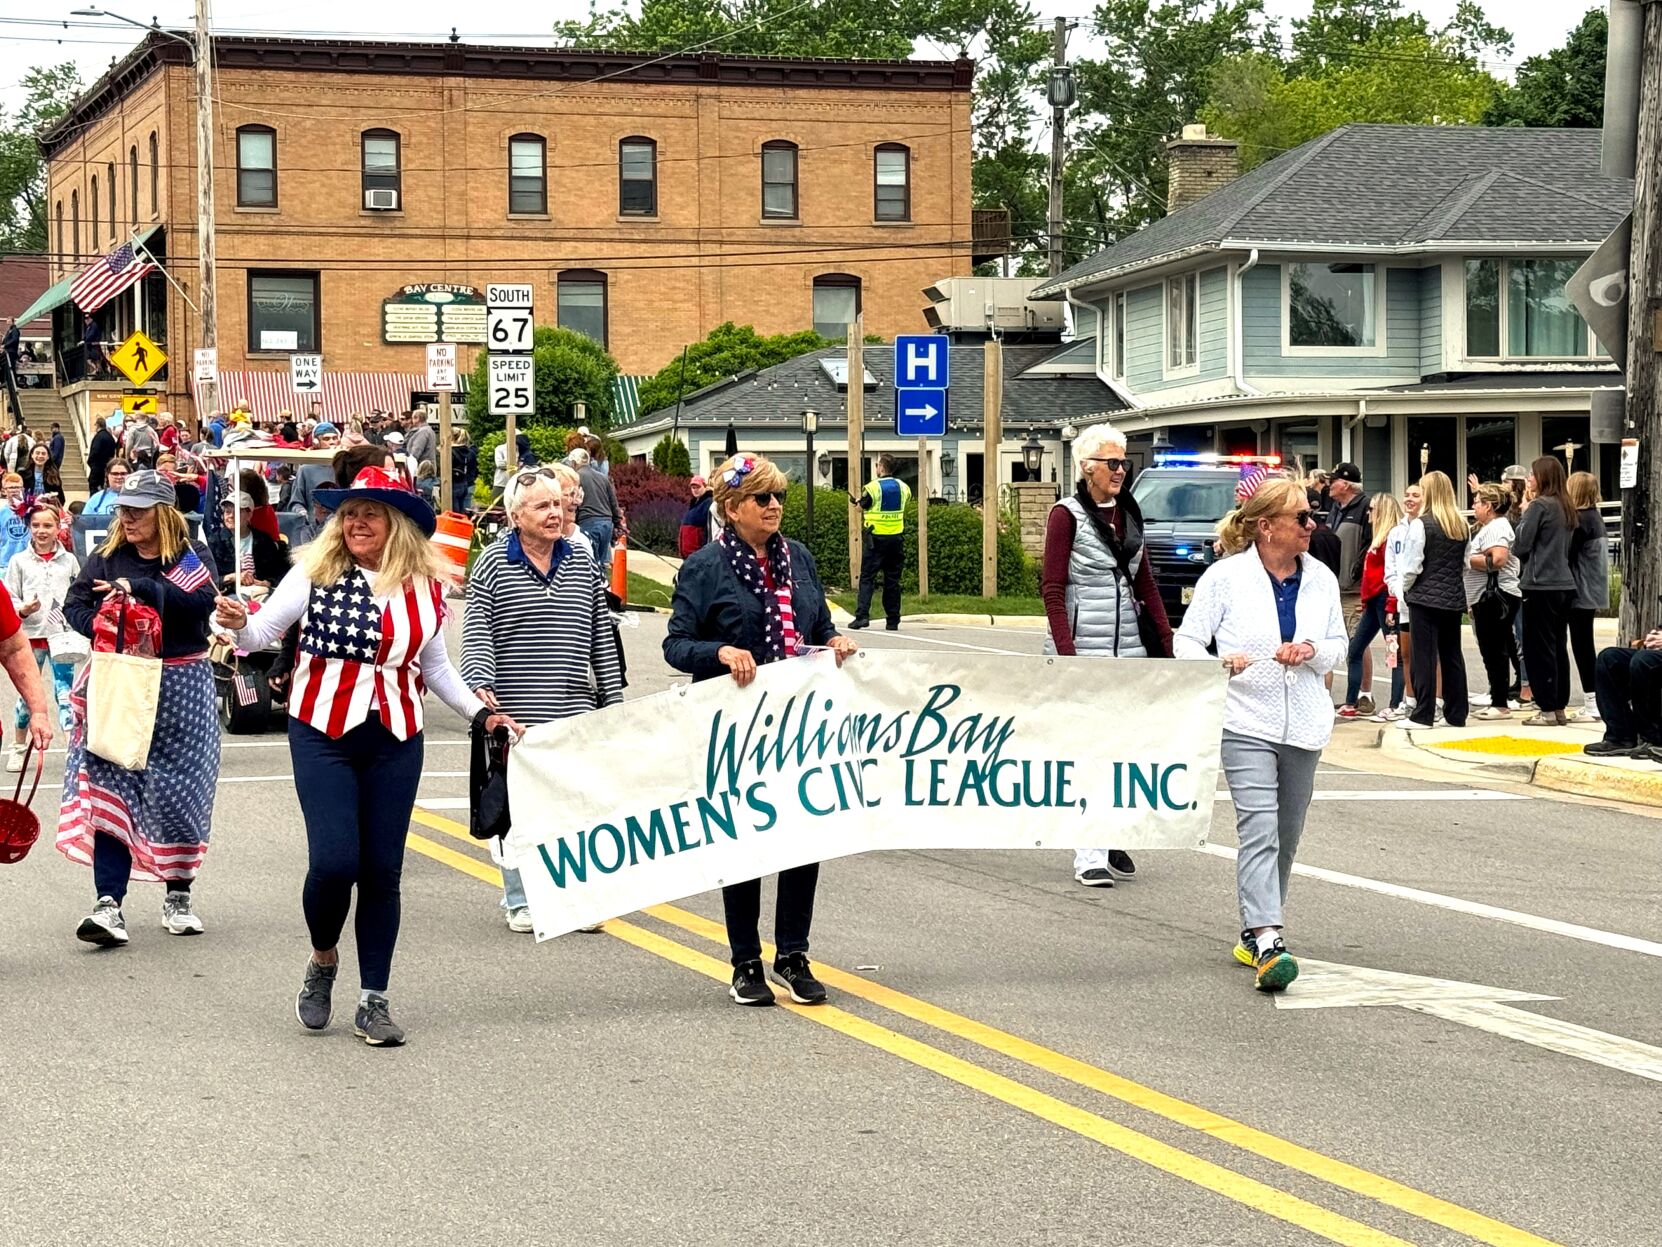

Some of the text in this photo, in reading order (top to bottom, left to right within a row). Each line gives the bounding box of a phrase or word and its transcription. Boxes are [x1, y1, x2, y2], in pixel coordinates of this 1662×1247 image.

[403, 283, 474, 295] BAY CENTRE
[489, 287, 530, 303] SOUTH
[492, 317, 528, 343] 67
[436, 348, 447, 357] NO
[295, 358, 317, 366] ONE
[429, 359, 454, 367] PARKING
[492, 360, 530, 370] SPEED
[907, 343, 937, 381] H
[295, 369, 318, 378] WAY
[496, 372, 526, 382] LIMIT
[495, 388, 530, 408] 25
[706, 683, 1016, 799] Williams Bay
[537, 781, 778, 889] WOMEN'S
[904, 757, 1088, 815] LEAGUE,
[1113, 761, 1199, 812] INC.
